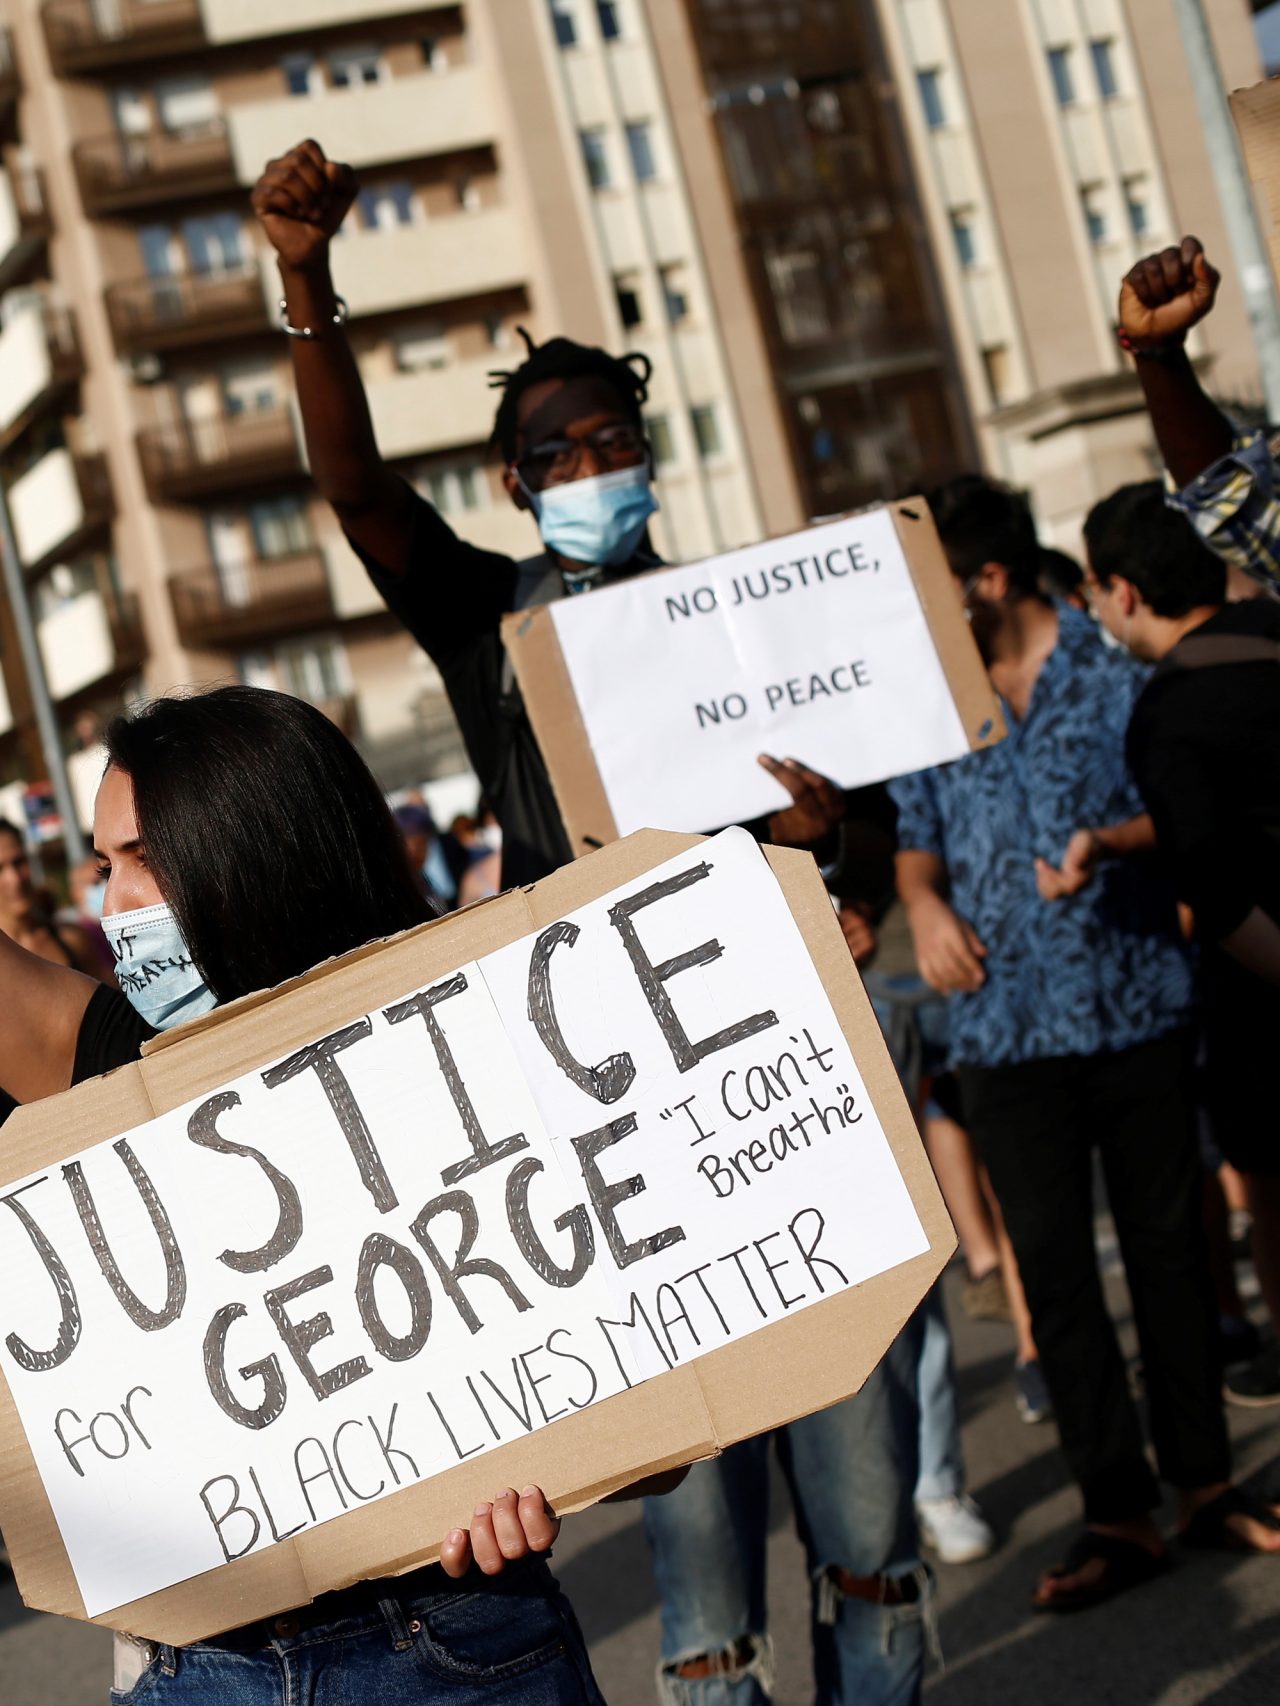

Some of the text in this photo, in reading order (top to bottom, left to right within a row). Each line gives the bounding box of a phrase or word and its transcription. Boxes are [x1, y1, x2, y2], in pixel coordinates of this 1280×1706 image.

[665, 542, 881, 622] NO JUSTICE,
[696, 660, 872, 729] NO PEACE
[659, 1094, 716, 1147] "I
[55, 1112, 686, 1475] for GEORGE
[200, 1207, 849, 1562] BLACK LIVES MATTER
